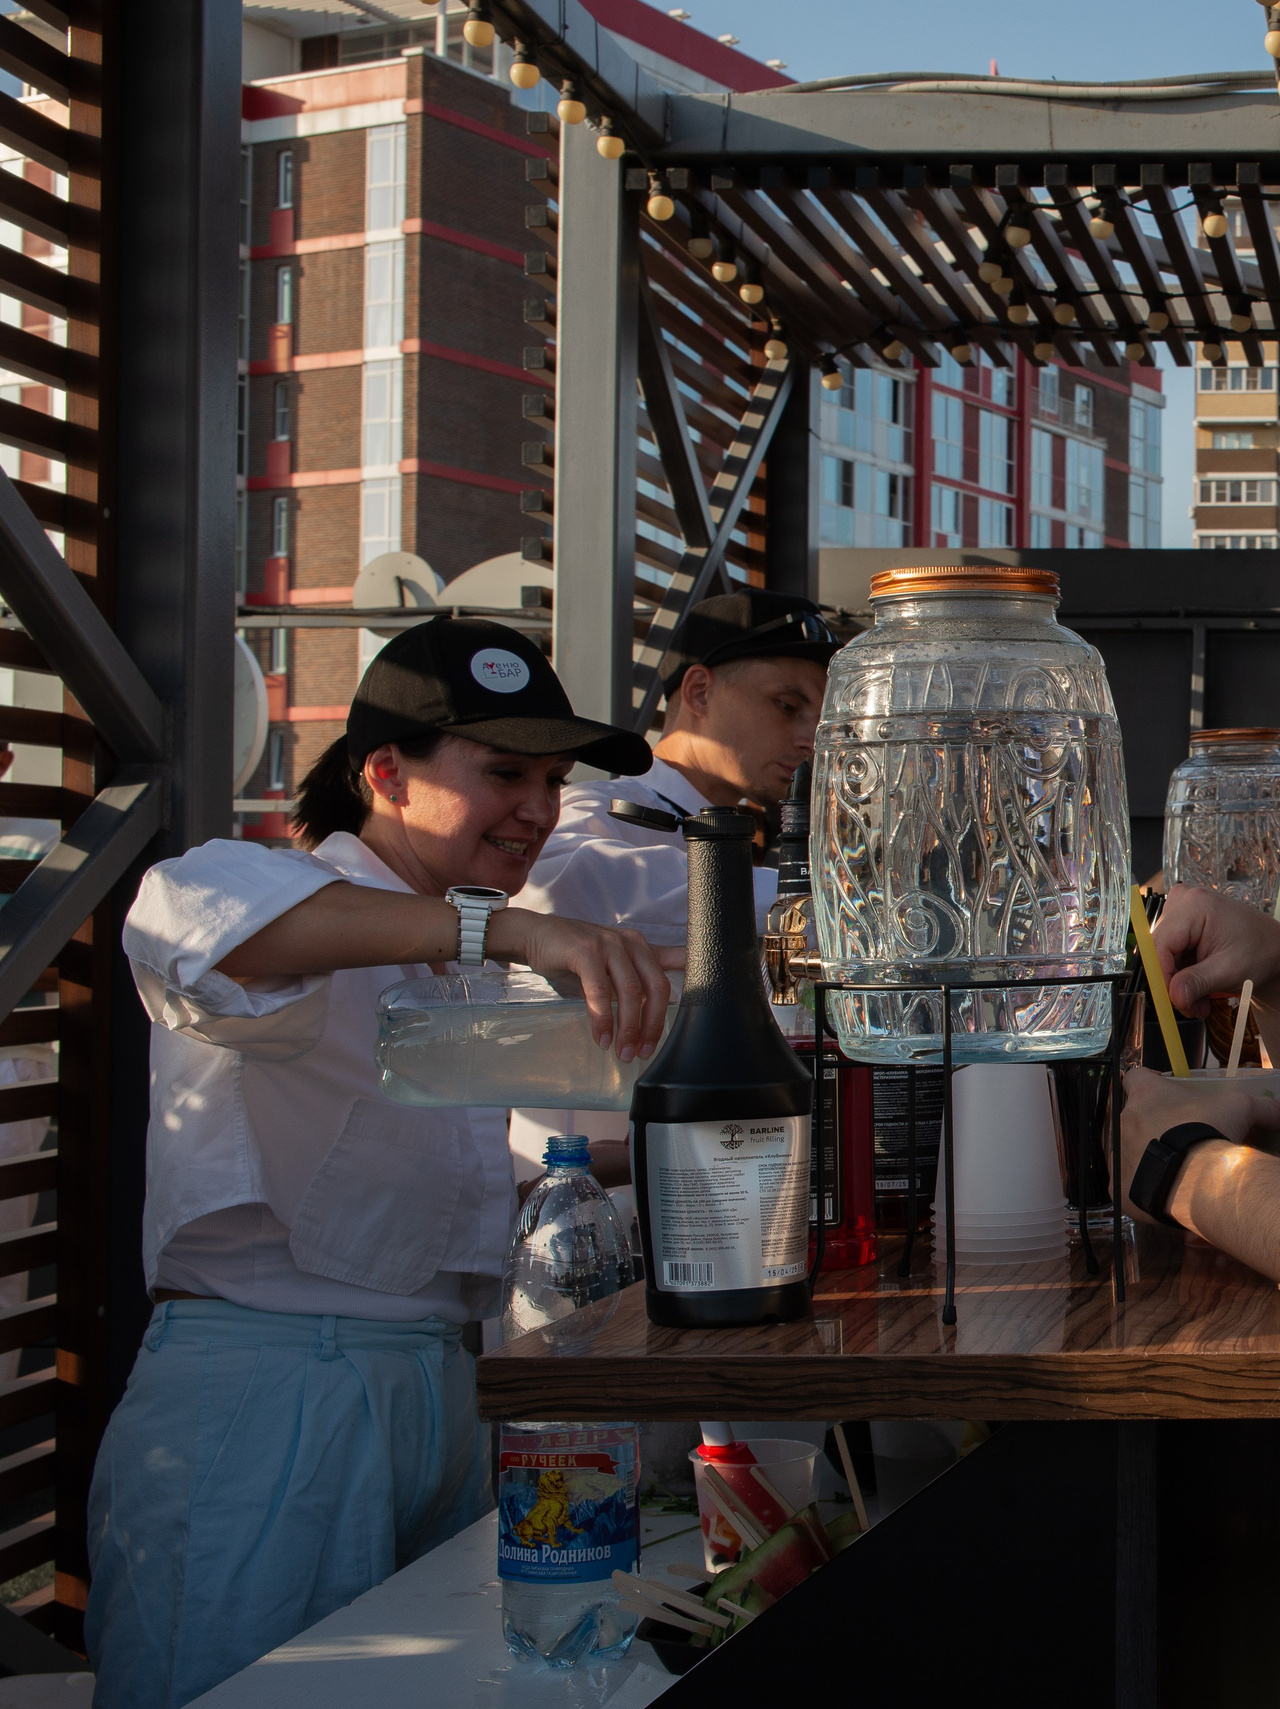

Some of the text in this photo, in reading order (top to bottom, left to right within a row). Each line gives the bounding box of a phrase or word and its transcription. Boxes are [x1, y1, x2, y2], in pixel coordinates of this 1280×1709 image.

[498, 668, 522, 678] БАР
[750, 1126, 785, 1135] BARLINE
[521, 1455, 577, 1467] РУЧЕЕК
[499, 1541, 611, 1566] Долина Родников
